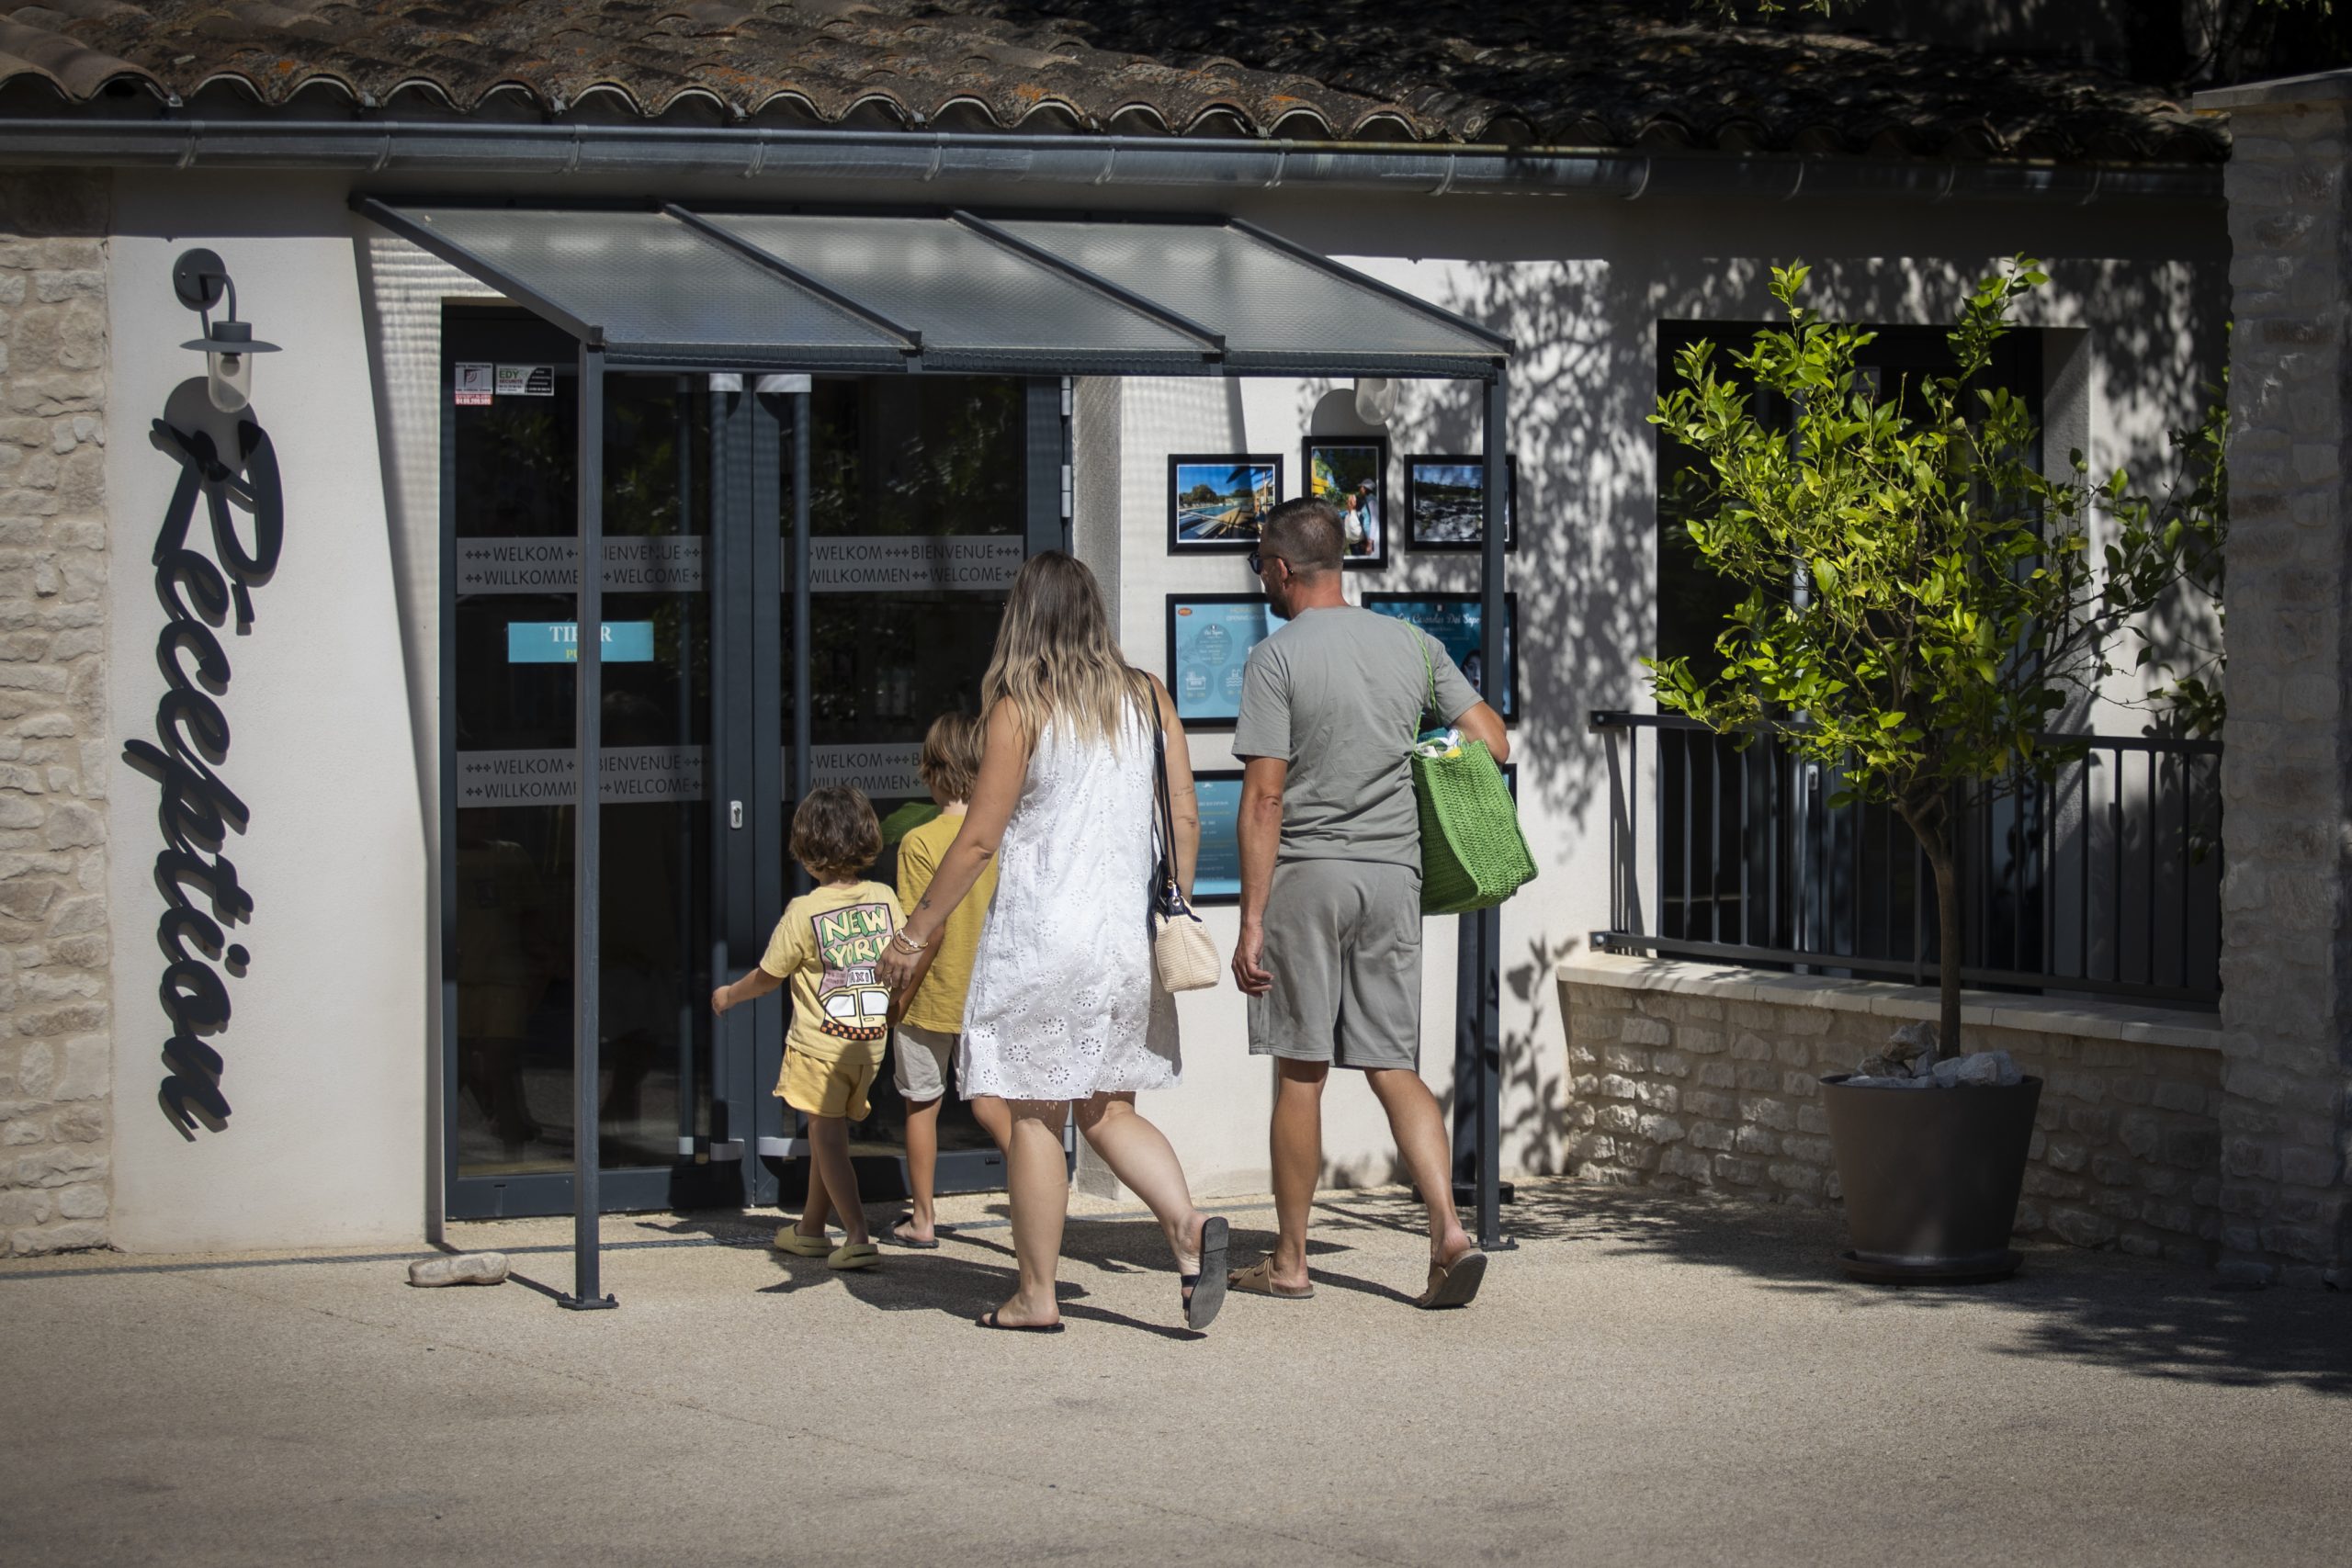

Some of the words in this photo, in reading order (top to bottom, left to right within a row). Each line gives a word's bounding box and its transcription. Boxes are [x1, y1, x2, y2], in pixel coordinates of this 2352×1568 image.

[493, 546, 564, 561] WELKOM
[603, 545, 681, 560] IENVENUE
[815, 546, 883, 560] WELKOM
[911, 544, 994, 559] BIENVENUE
[485, 570, 578, 585] WILLKOMME
[614, 568, 689, 584] WELCOME
[809, 568, 910, 584] WILLKOMMEN
[930, 567, 1002, 582] WELCOME
[493, 758, 564, 774] WELKOM
[816, 752, 883, 768] WELKOM
[485, 782, 576, 798] WILLKOMM
[614, 778, 689, 795] WELCOME
[810, 775, 910, 790] WILLKOMMEN
[820, 907, 888, 948] NEW
[848, 971, 870, 984] AXI
